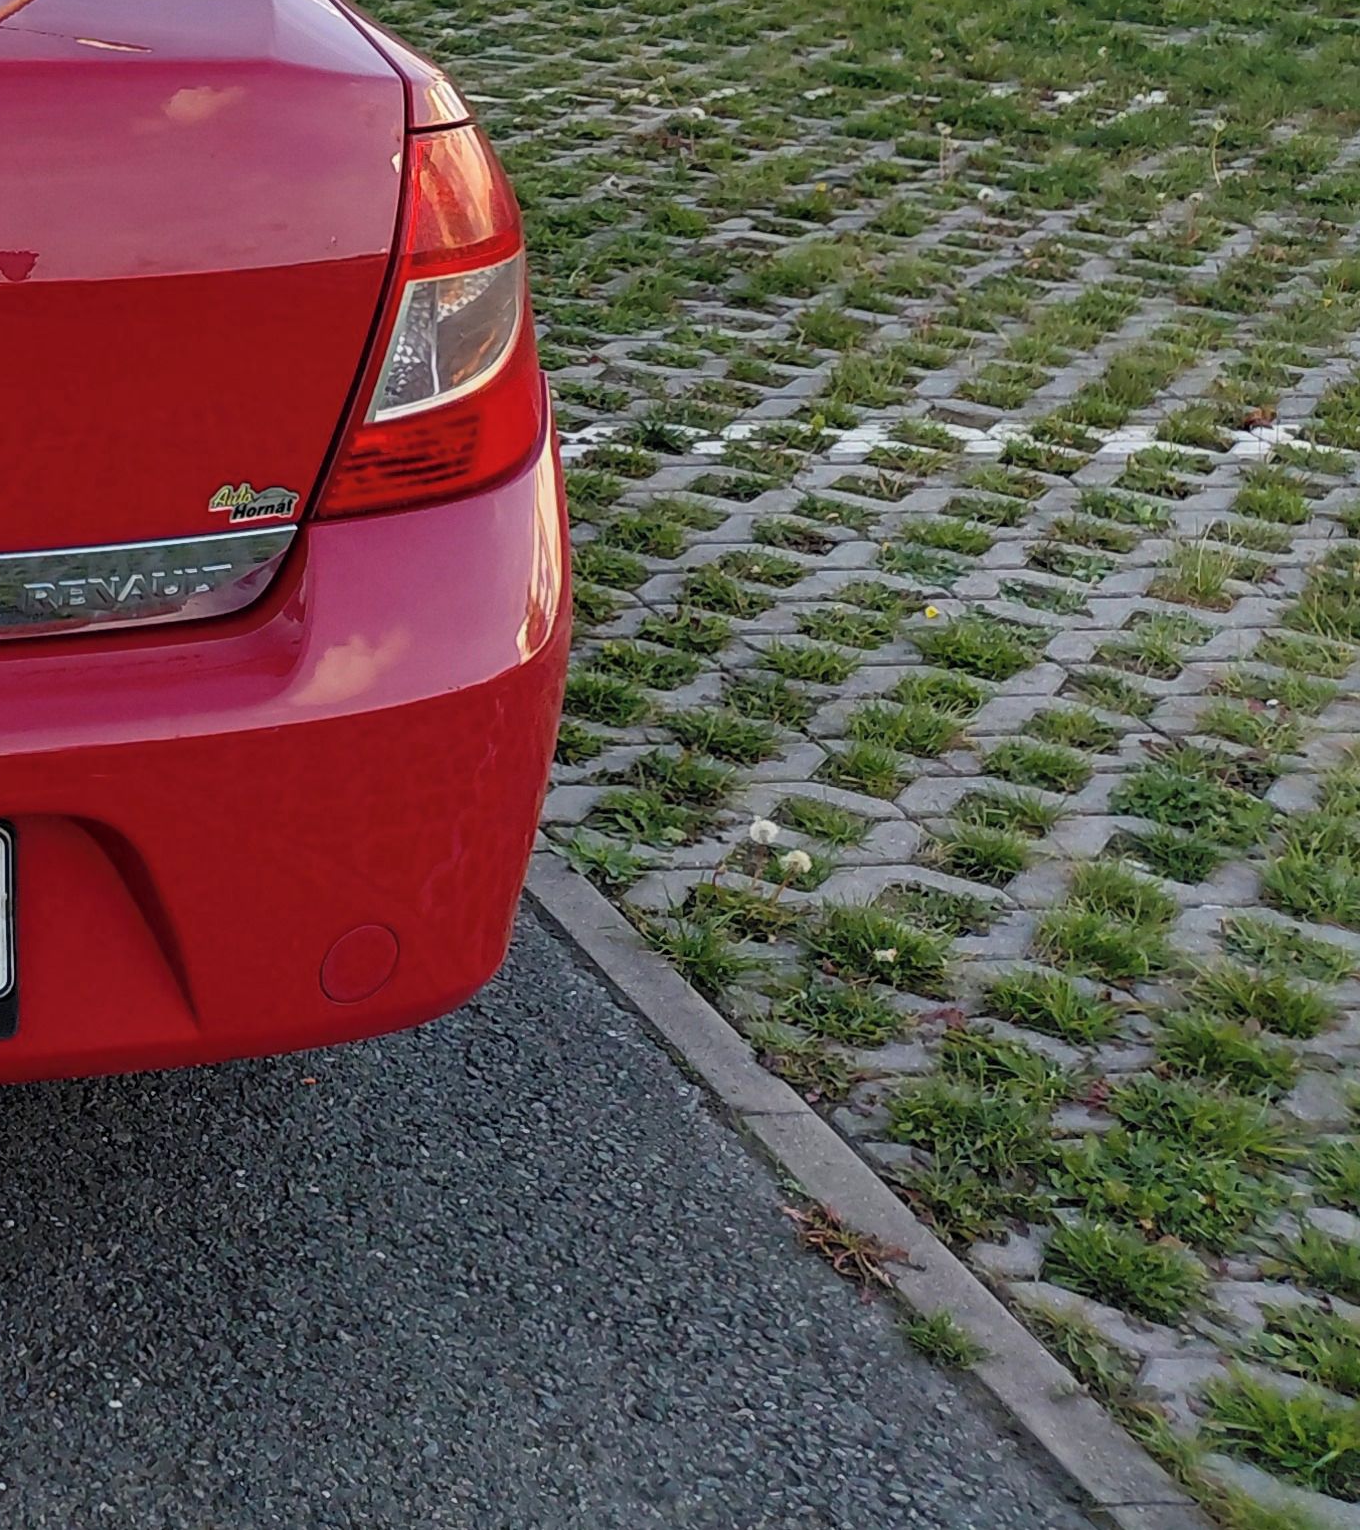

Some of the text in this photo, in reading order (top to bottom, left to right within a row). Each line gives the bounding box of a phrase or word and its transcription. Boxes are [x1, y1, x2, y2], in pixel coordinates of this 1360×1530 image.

[212, 485, 253, 508] Auto
[232, 498, 294, 520] Hornát
[23, 563, 232, 609] RENAULT
